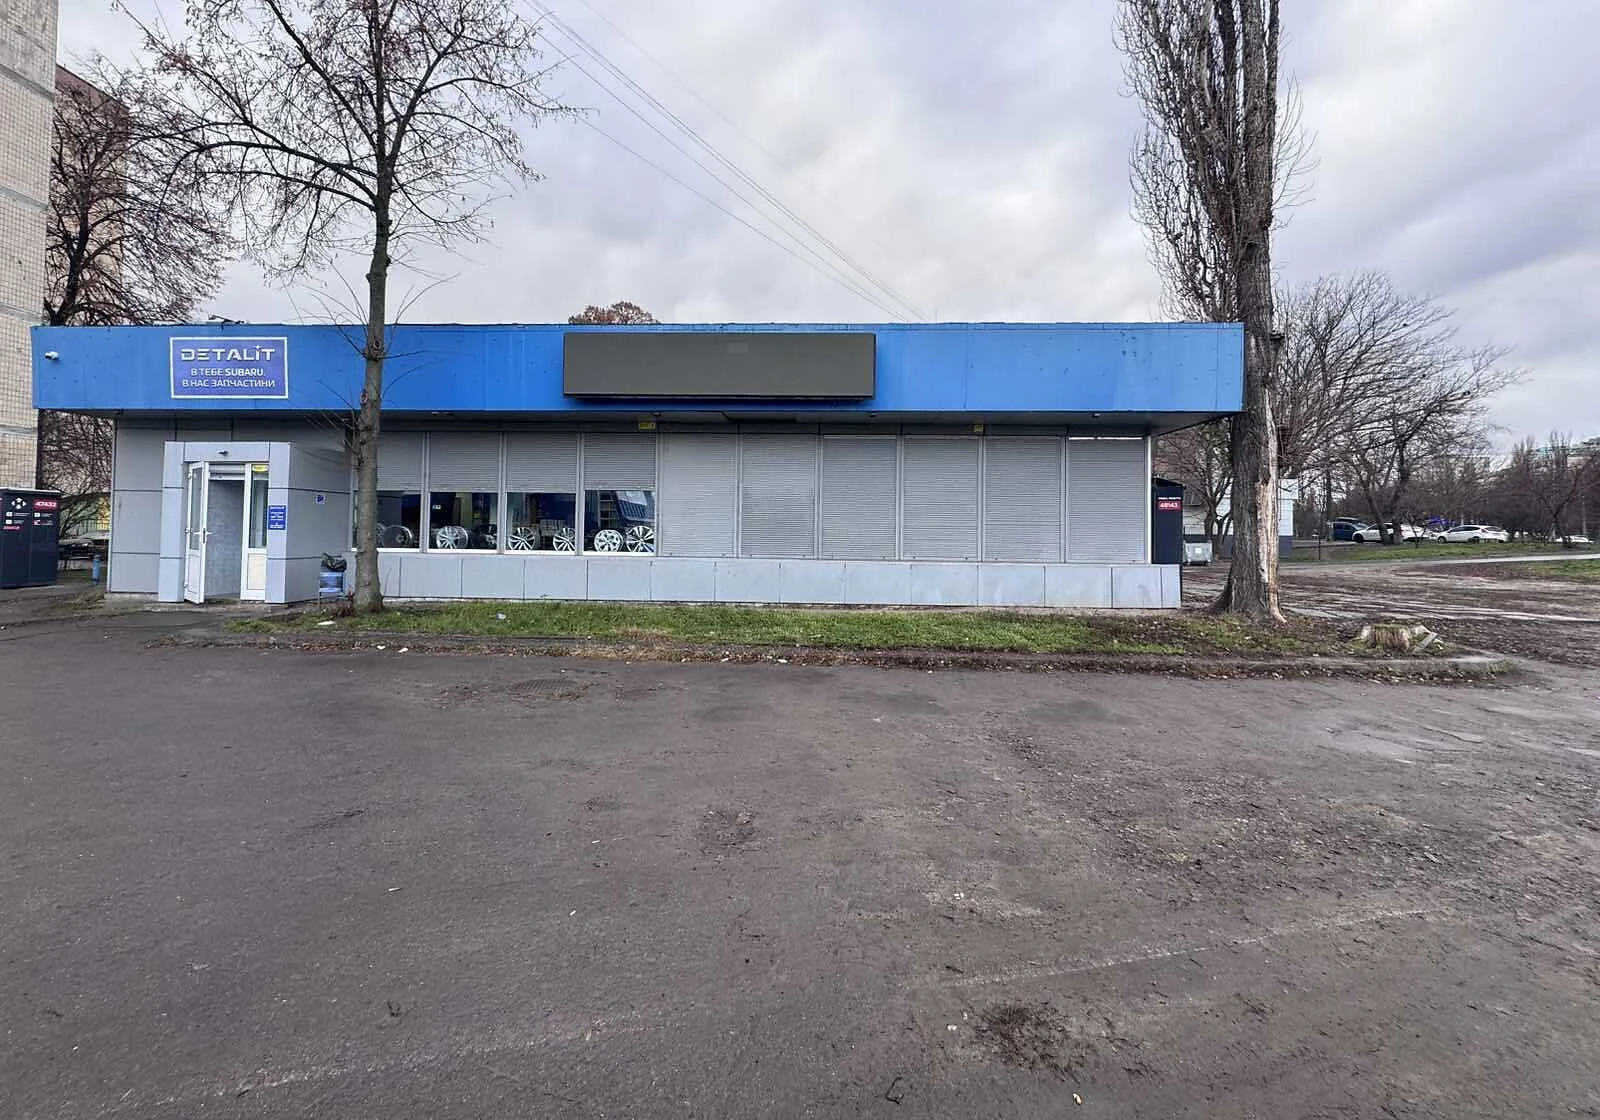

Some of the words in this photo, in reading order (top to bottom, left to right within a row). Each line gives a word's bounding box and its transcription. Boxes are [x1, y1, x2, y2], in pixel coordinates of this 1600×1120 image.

[191, 367, 198, 376] В
[200, 367, 224, 376] ТЕБЕ
[182, 379, 189, 388] В
[191, 379, 209, 388] НАС
[211, 379, 276, 388] ЗАПЧАСТИНИ
